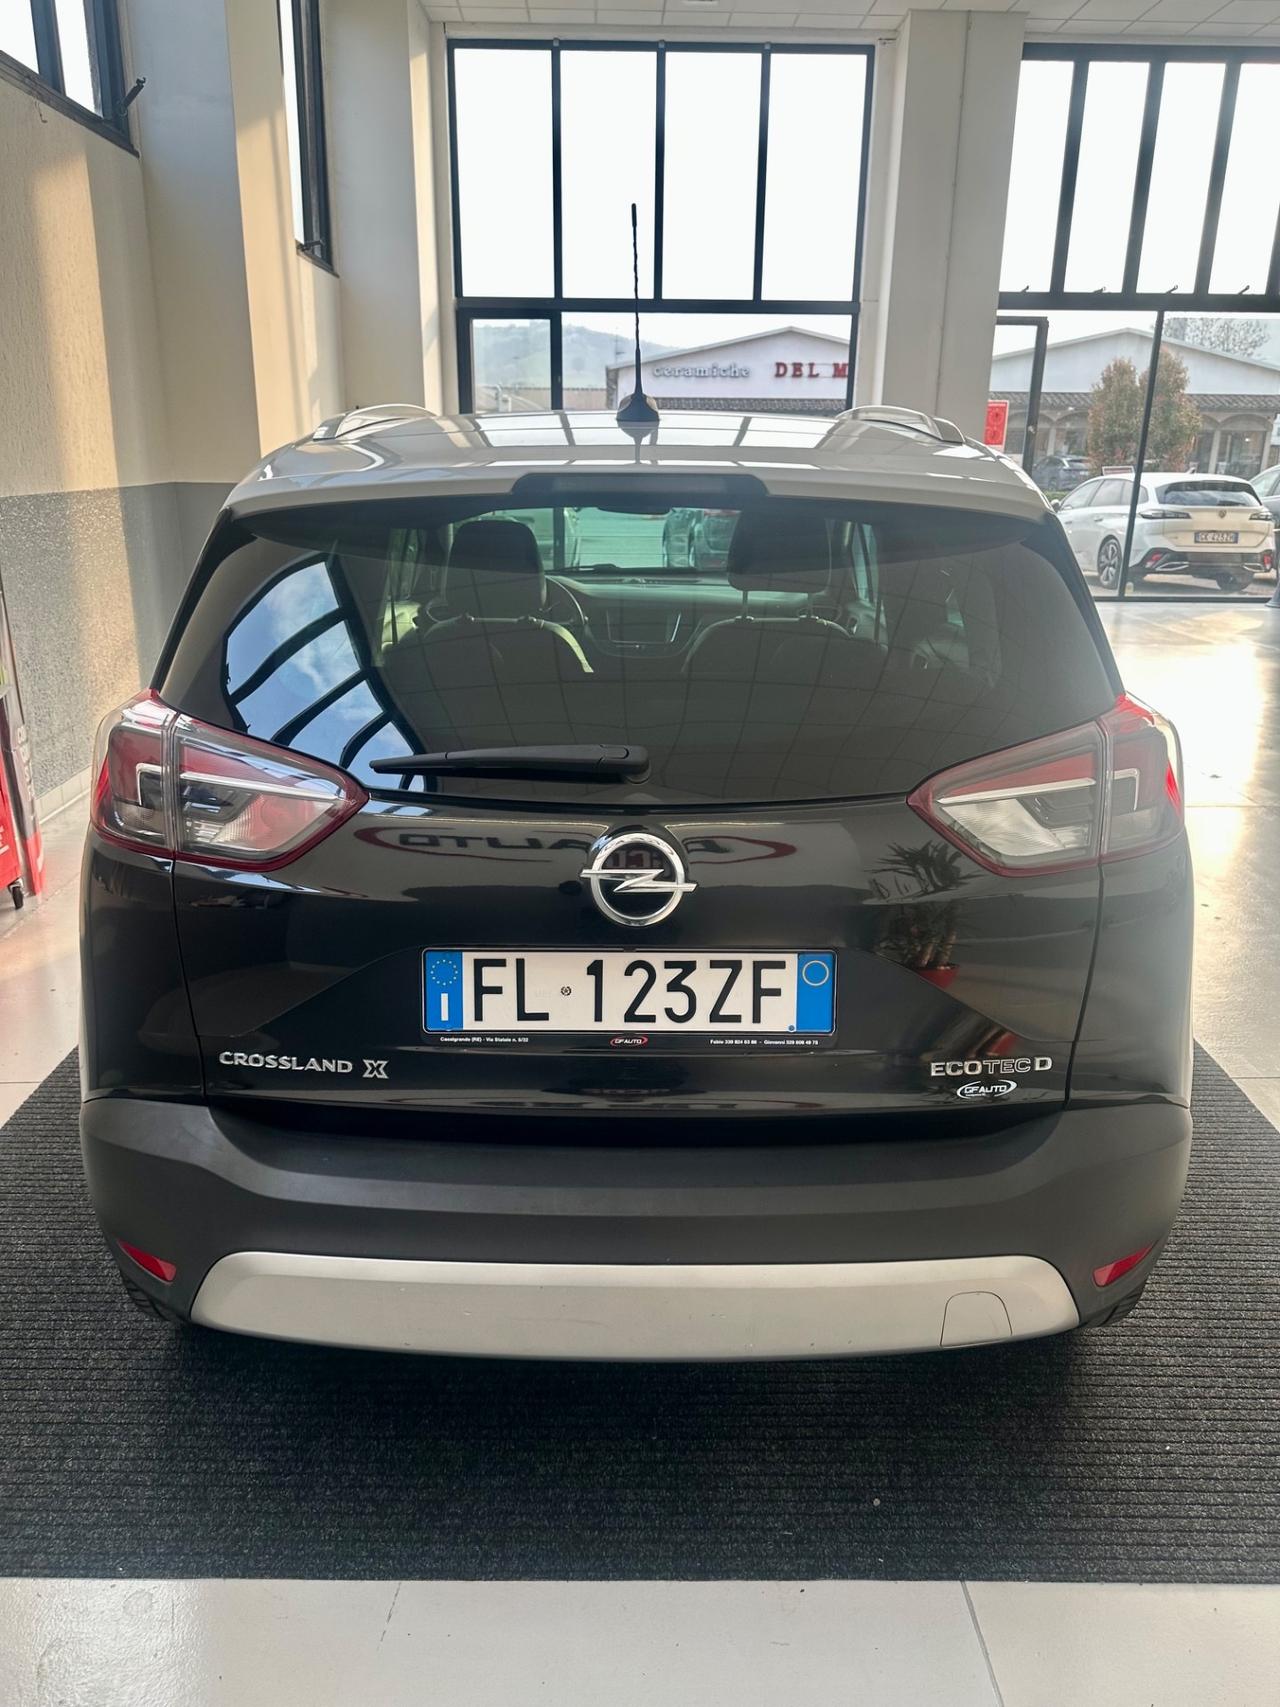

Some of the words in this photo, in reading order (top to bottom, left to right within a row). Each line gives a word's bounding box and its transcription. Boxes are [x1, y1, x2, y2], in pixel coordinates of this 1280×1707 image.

[653, 363, 750, 378] ceramiche
[774, 362, 820, 378] DEL
[473, 957, 550, 1022] FL
[586, 959, 787, 1024] 123ZF
[219, 1051, 353, 1073] CROSSLAND
[362, 1059, 389, 1079] X
[930, 1057, 1031, 1077] ECOTEC
[1034, 1056, 1053, 1071] D
